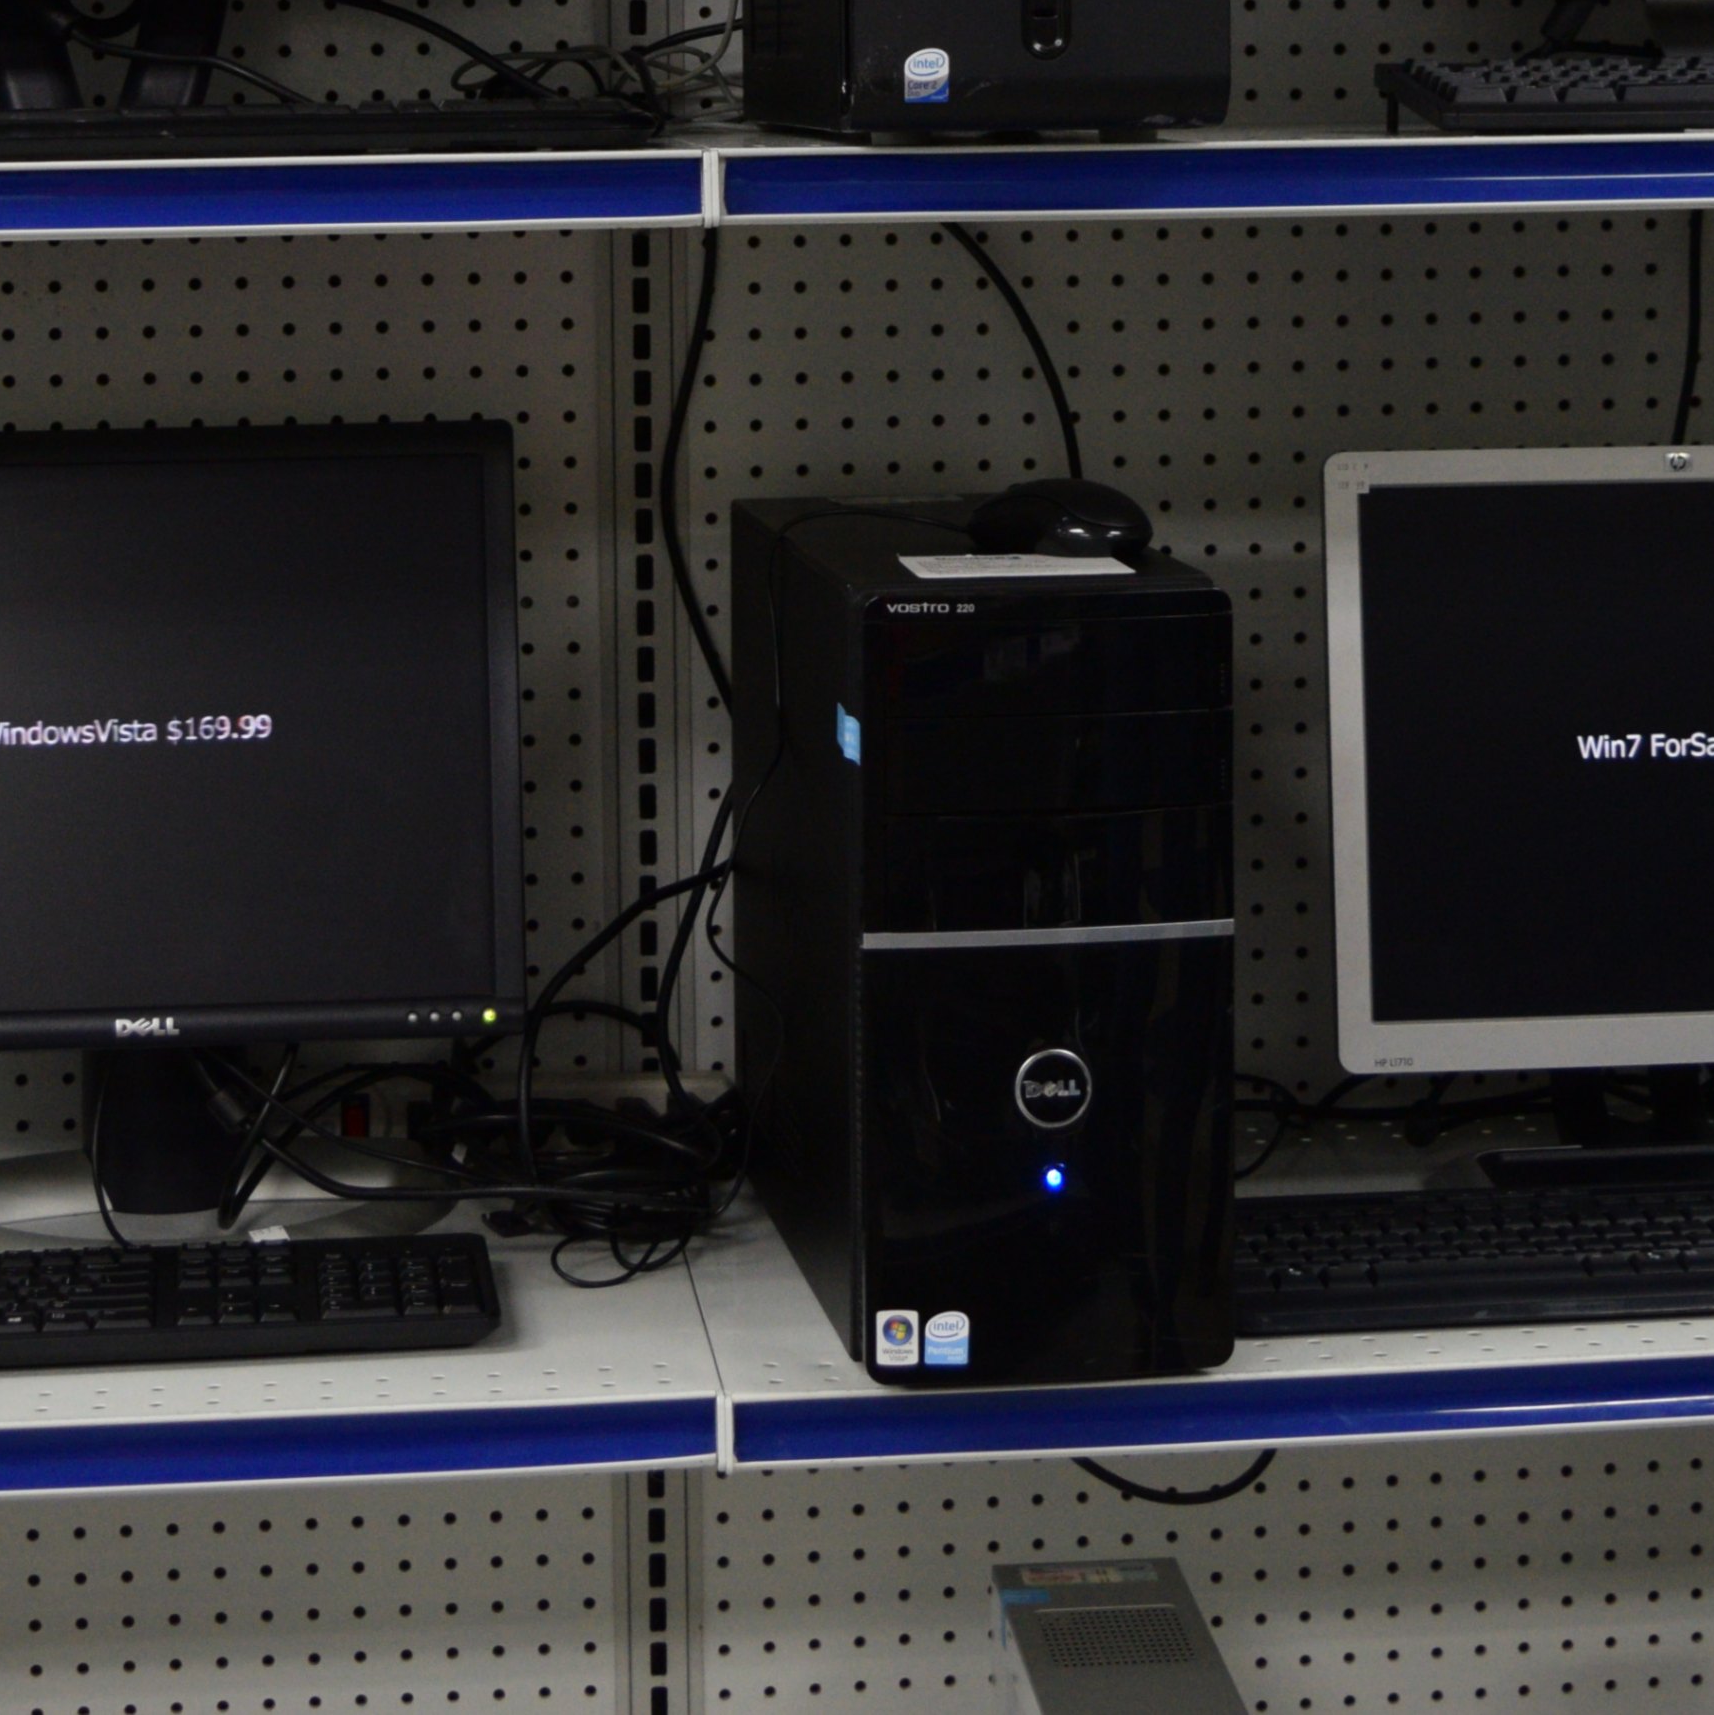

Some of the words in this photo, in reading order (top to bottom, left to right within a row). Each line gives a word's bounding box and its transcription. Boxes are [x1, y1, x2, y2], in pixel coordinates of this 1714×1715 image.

[912, 56, 942, 70] intel
[956, 603, 975, 614] 220
[165, 713, 273, 746] $169.99
[1576, 732, 1643, 760] Win7
[114, 1016, 180, 1038] DELL
[1022, 1078, 1082, 1099] DELL
[932, 1319, 961, 1333] intel
